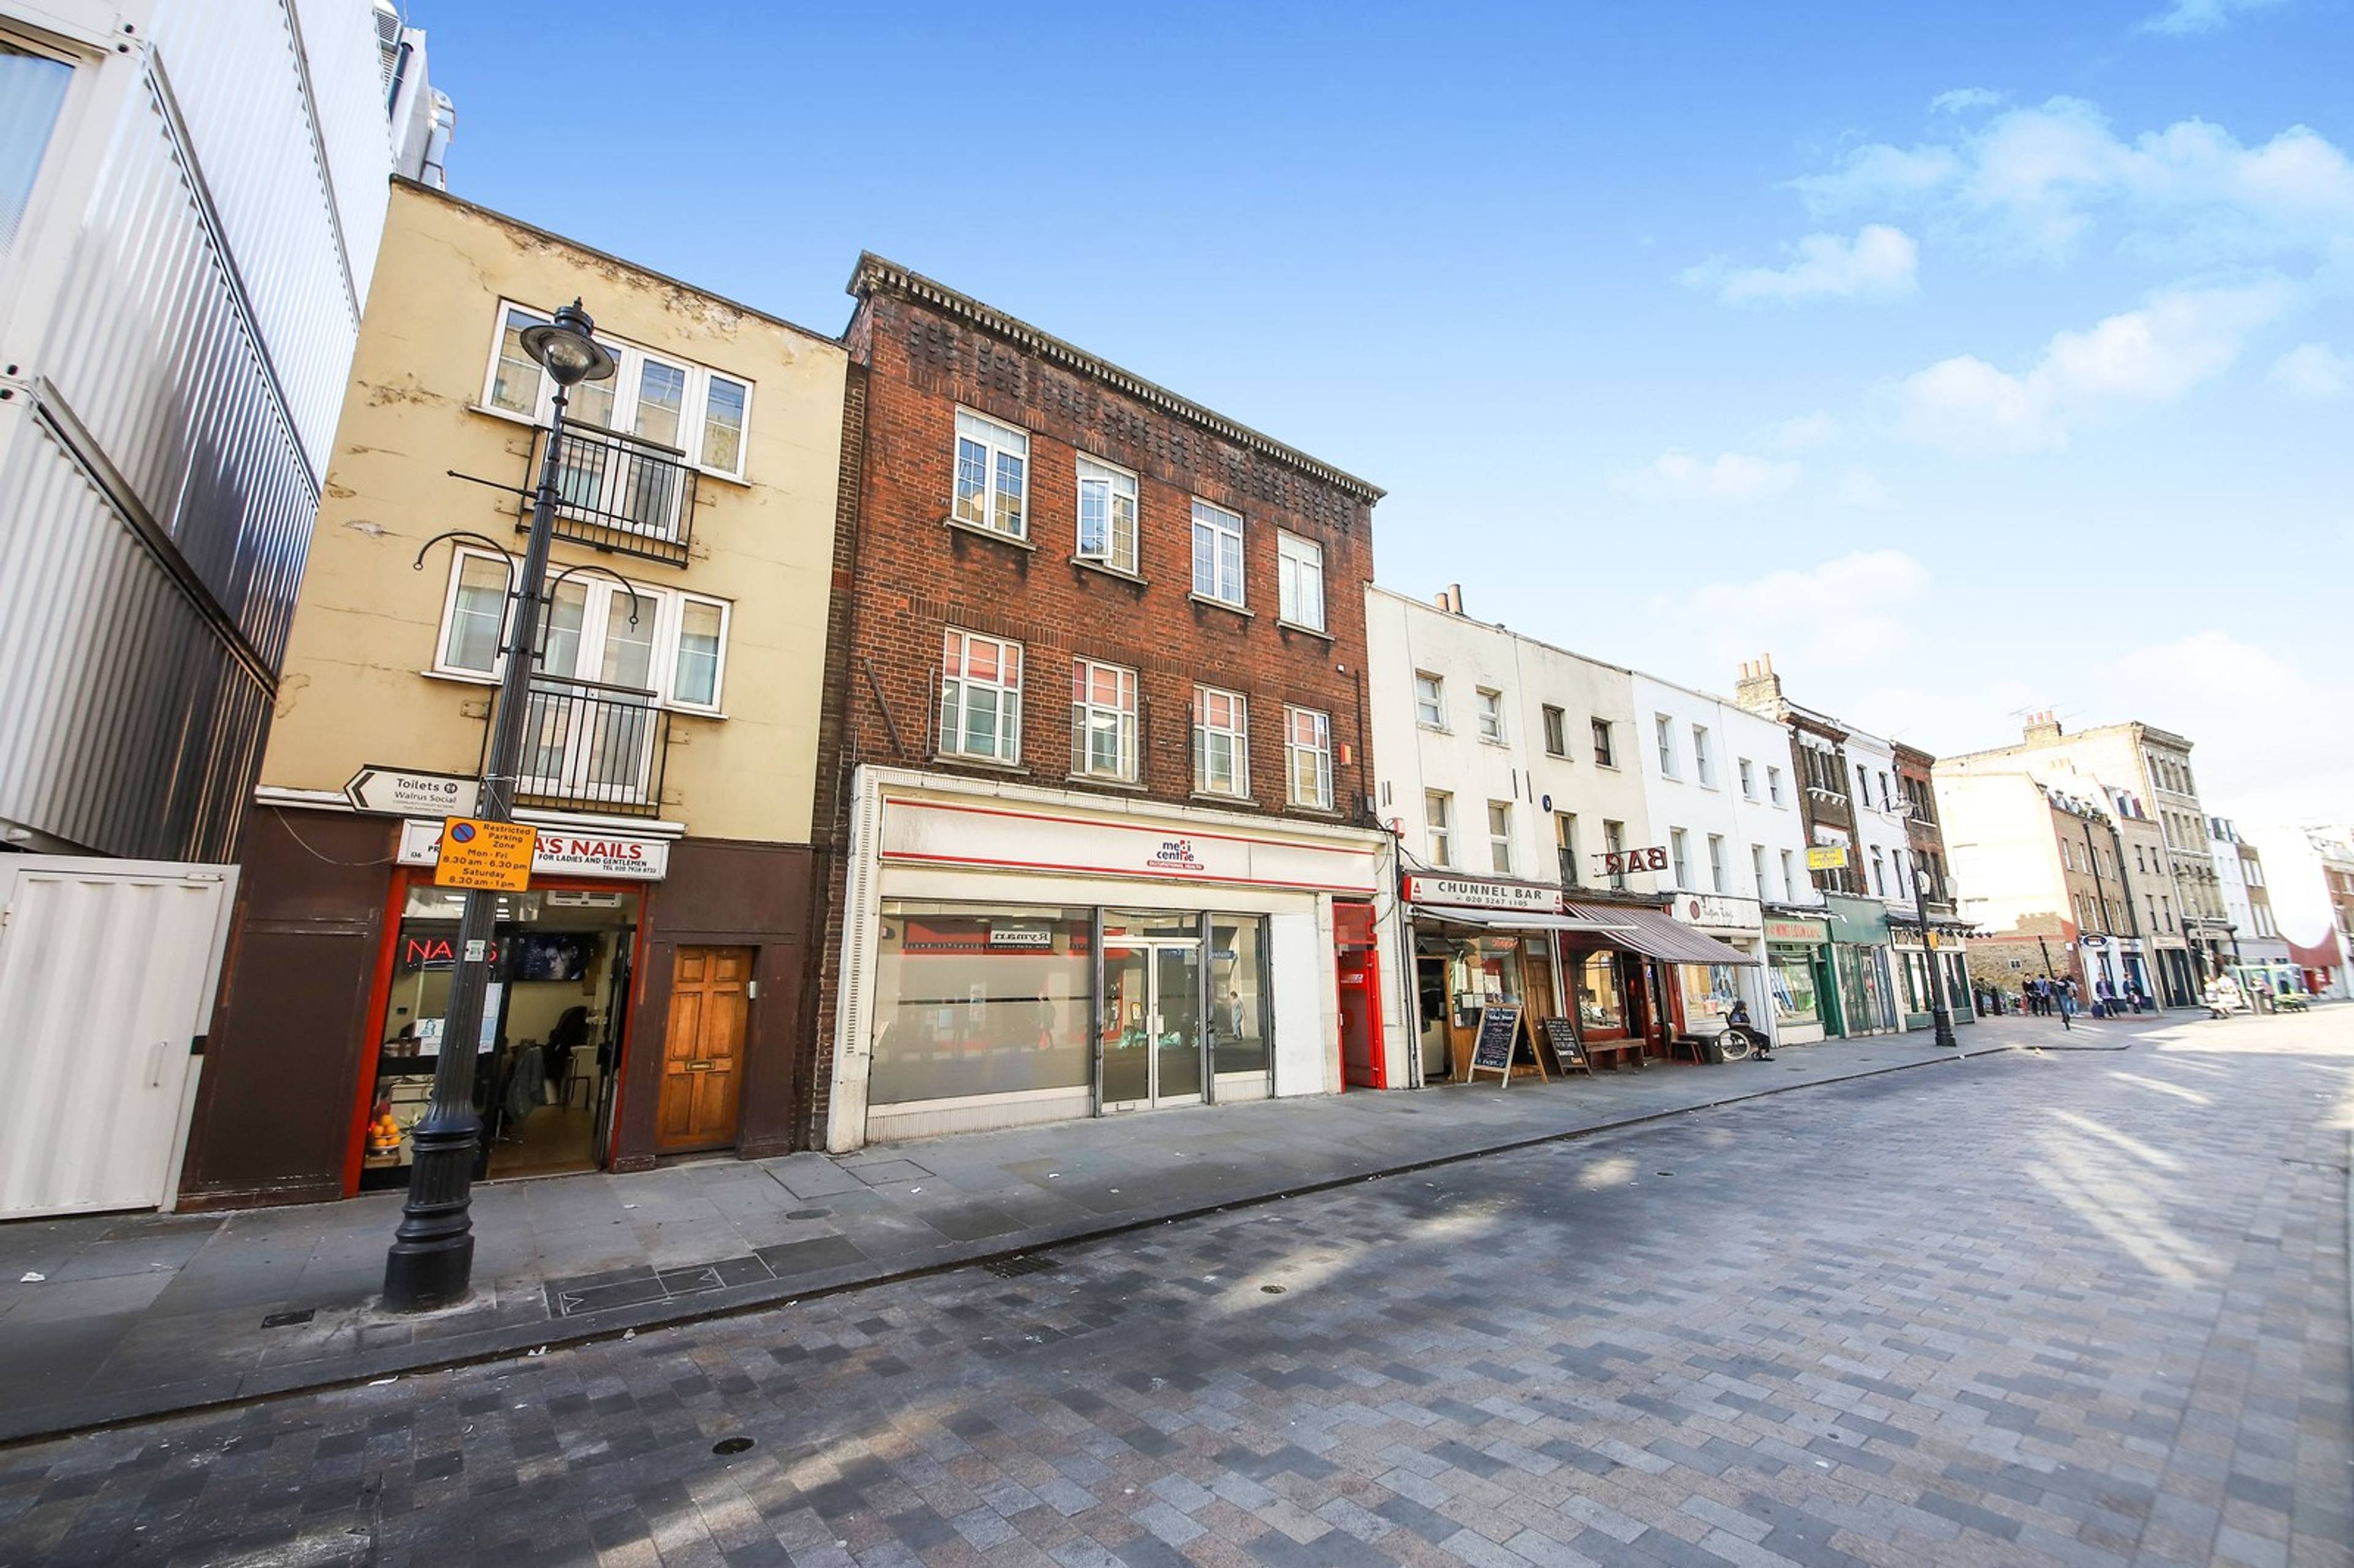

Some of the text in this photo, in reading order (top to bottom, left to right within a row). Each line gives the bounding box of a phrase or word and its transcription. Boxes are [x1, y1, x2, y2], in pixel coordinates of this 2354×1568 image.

[397, 778, 440, 791] Toilets
[394, 791, 457, 804] Walrus Social
[483, 823, 530, 835] Restricted
[489, 833, 523, 843] Parking
[467, 848, 488, 857] Mon
[571, 839, 642, 859] NAILS
[463, 867, 506, 879] Saturday
[1438, 881, 1542, 900] CHUNNEL BAR
